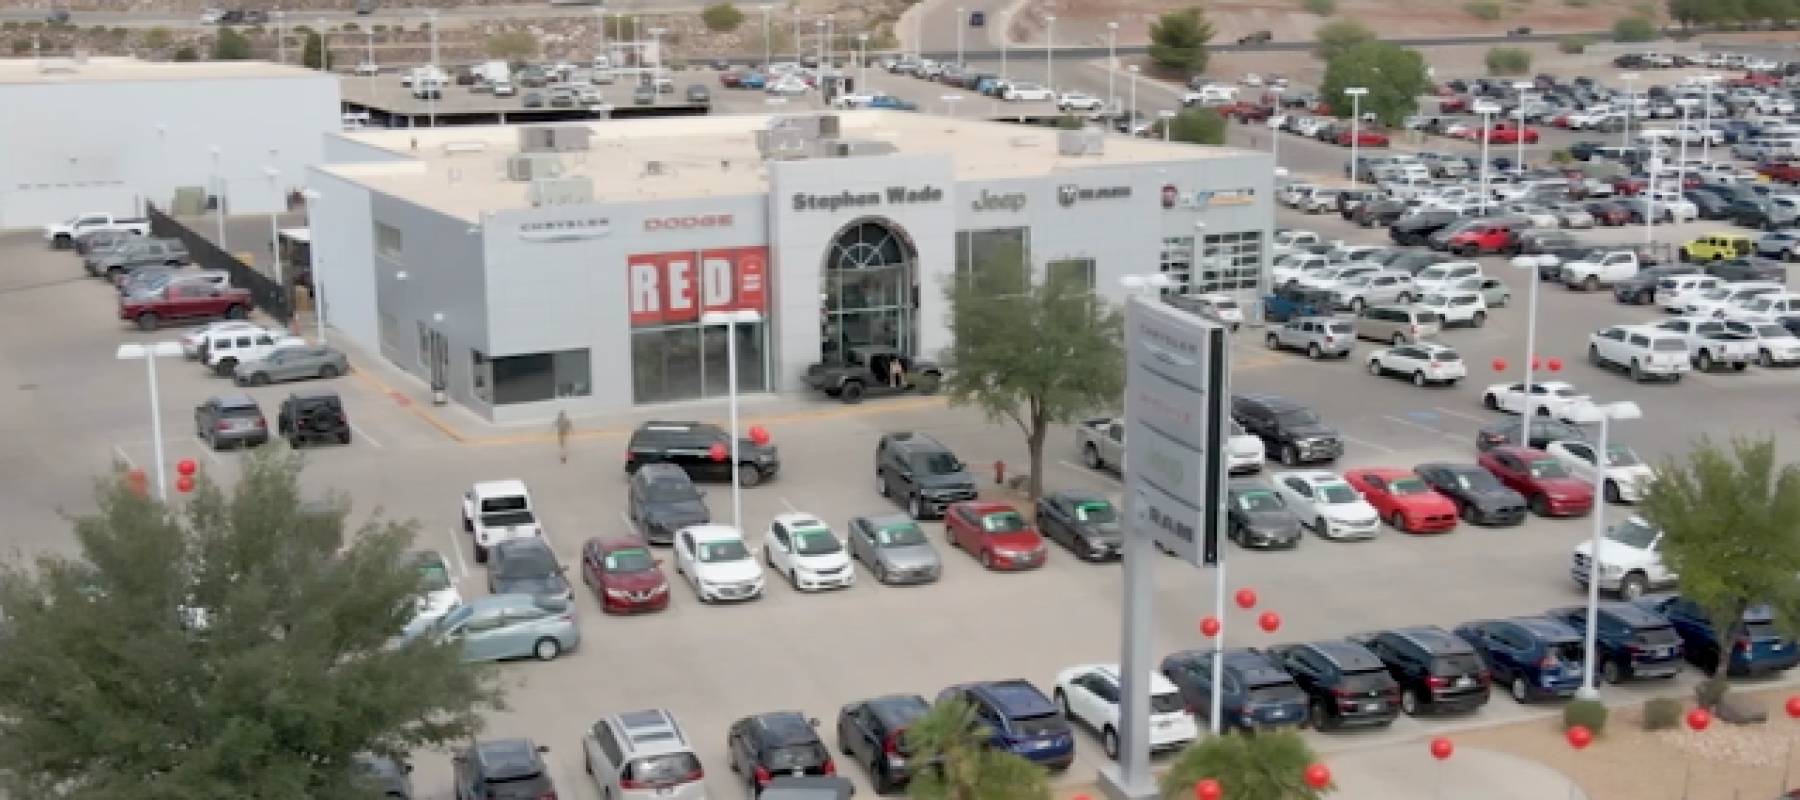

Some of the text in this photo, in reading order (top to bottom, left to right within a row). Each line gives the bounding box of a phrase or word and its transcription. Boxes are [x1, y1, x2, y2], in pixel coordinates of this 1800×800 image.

[792, 185, 943, 212] Stephen Wade
[971, 188, 1026, 213] Jeep
[644, 213, 735, 231] DODGE
[630, 258, 731, 314] RED
